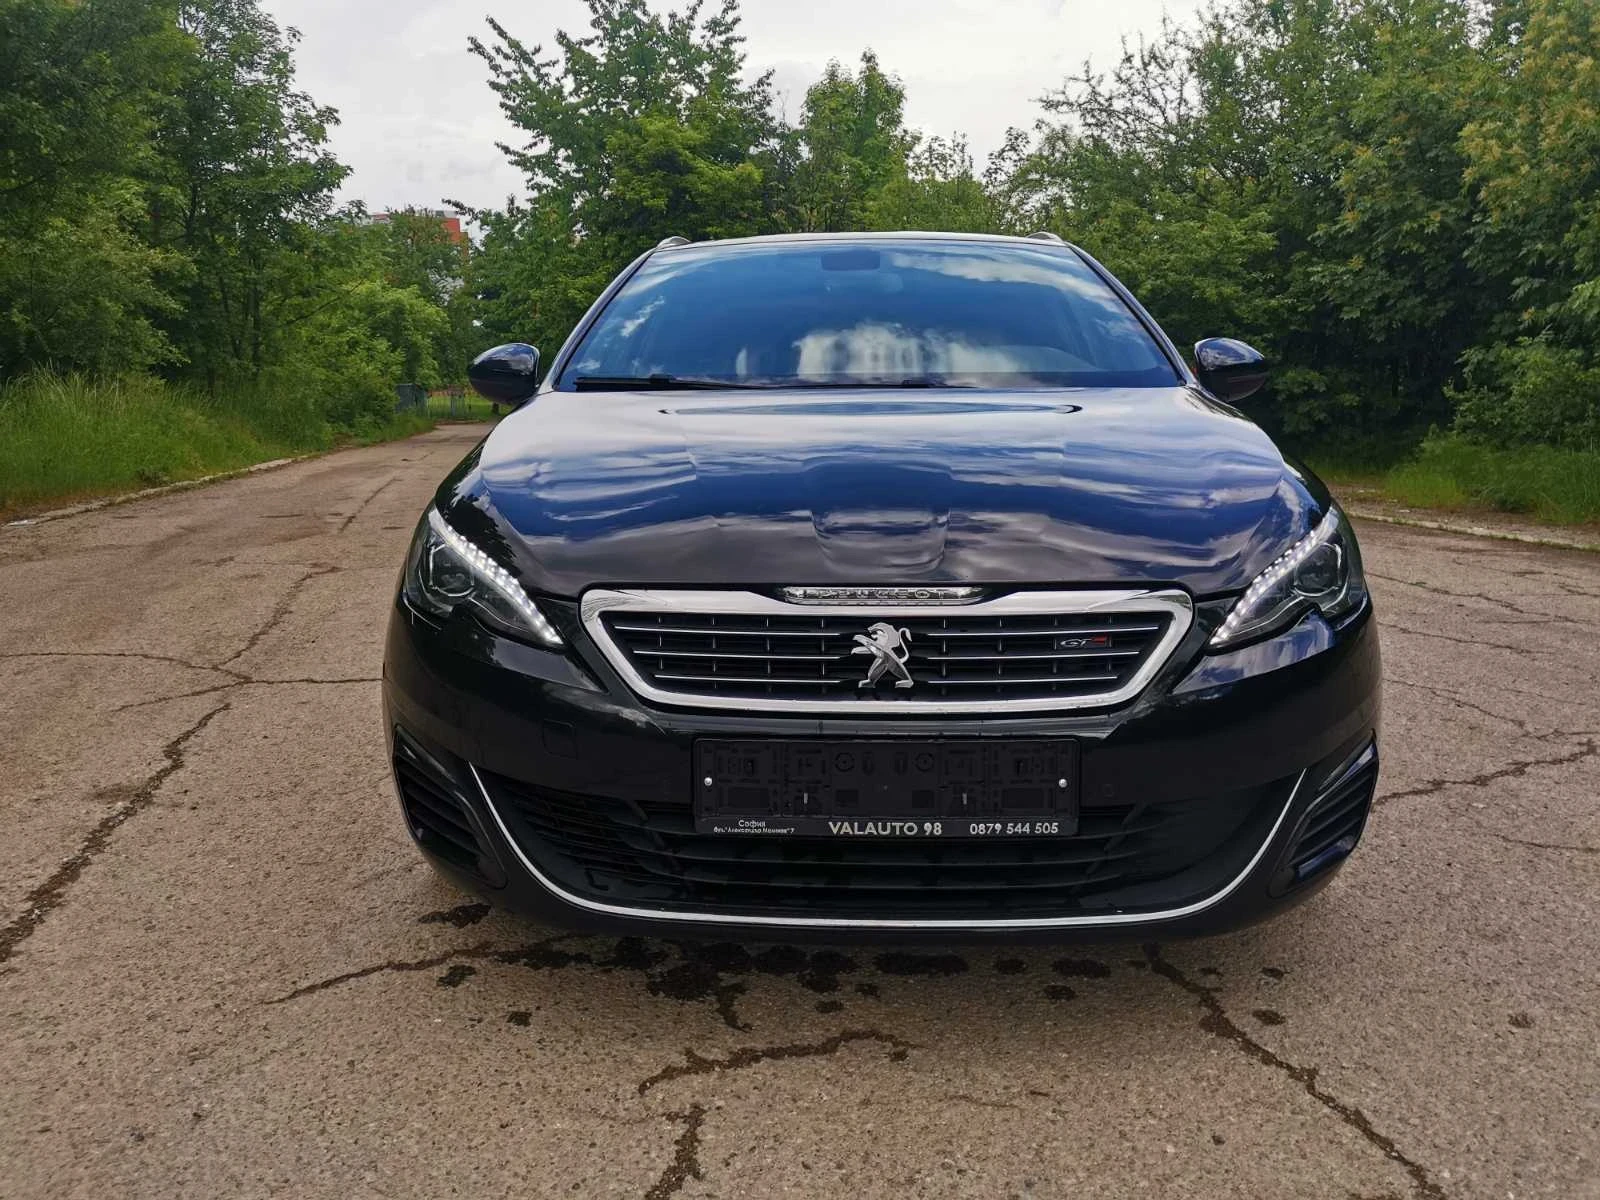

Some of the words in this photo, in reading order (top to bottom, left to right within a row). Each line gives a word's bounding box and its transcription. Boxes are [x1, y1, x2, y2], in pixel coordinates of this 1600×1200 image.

[819, 588, 948, 601] PEUGEOT
[738, 820, 766, 828] София
[828, 821, 918, 836] VALAUTO
[923, 822, 943, 836] 98
[969, 823, 1002, 835] 0879
[1006, 823, 1031, 834] 544
[1034, 822, 1059, 834] 505
